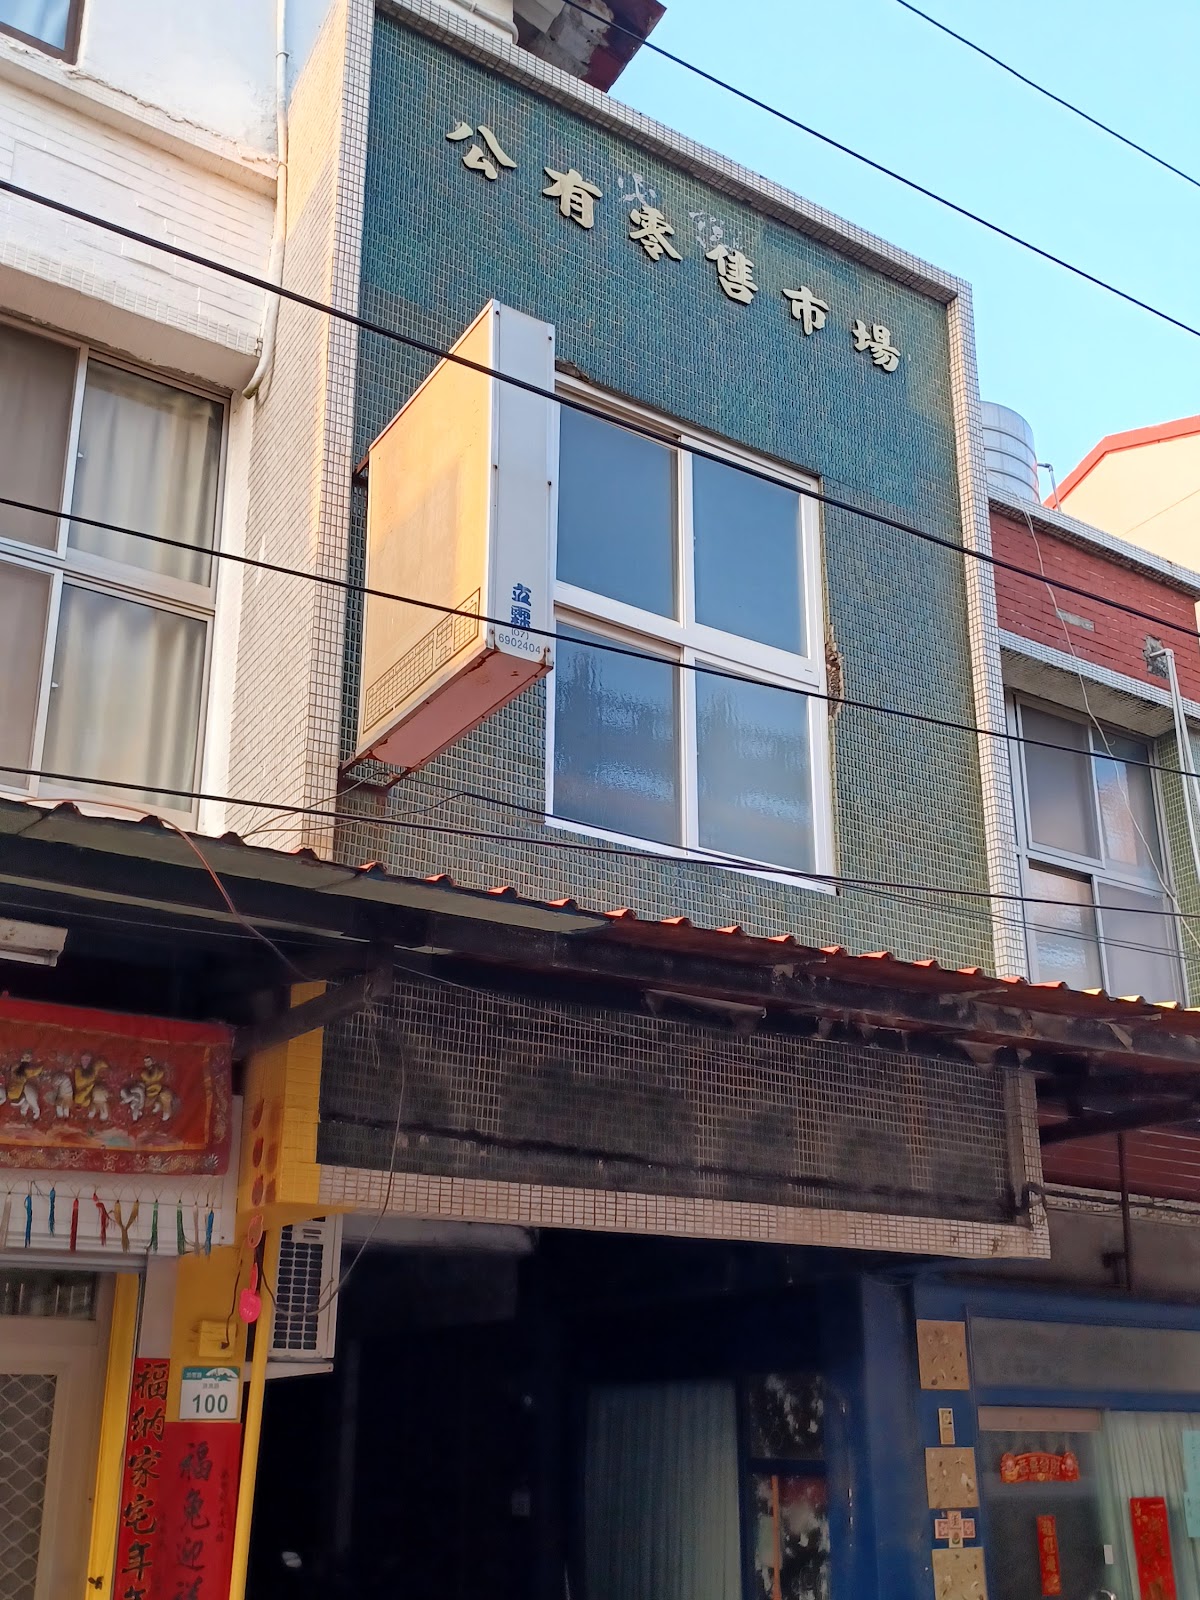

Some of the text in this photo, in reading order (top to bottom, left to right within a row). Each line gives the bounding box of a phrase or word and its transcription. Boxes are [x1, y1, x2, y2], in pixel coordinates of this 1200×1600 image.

[446, 121, 901, 372] 公有零售市場
[498, 633, 541, 654] 6902404
[192, 1394, 228, 1413] 100
